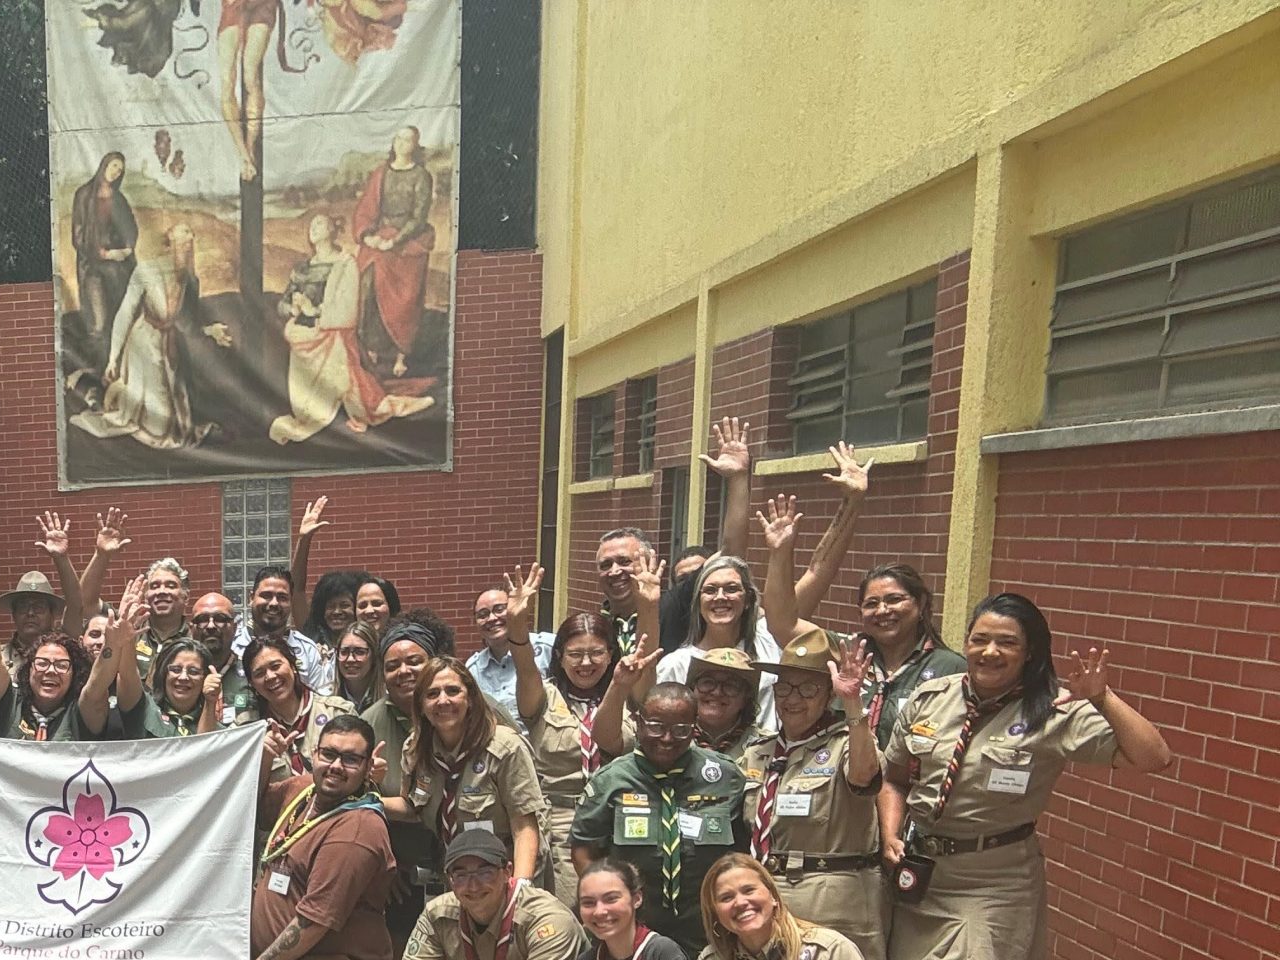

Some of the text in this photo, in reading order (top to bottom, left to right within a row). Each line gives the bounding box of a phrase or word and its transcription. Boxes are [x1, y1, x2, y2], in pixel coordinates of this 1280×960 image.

[4, 919, 74, 939] Distrito
[80, 921, 165, 939] Escoteiro
[58, 945, 80, 959] do
[86, 944, 145, 960] Carmo
